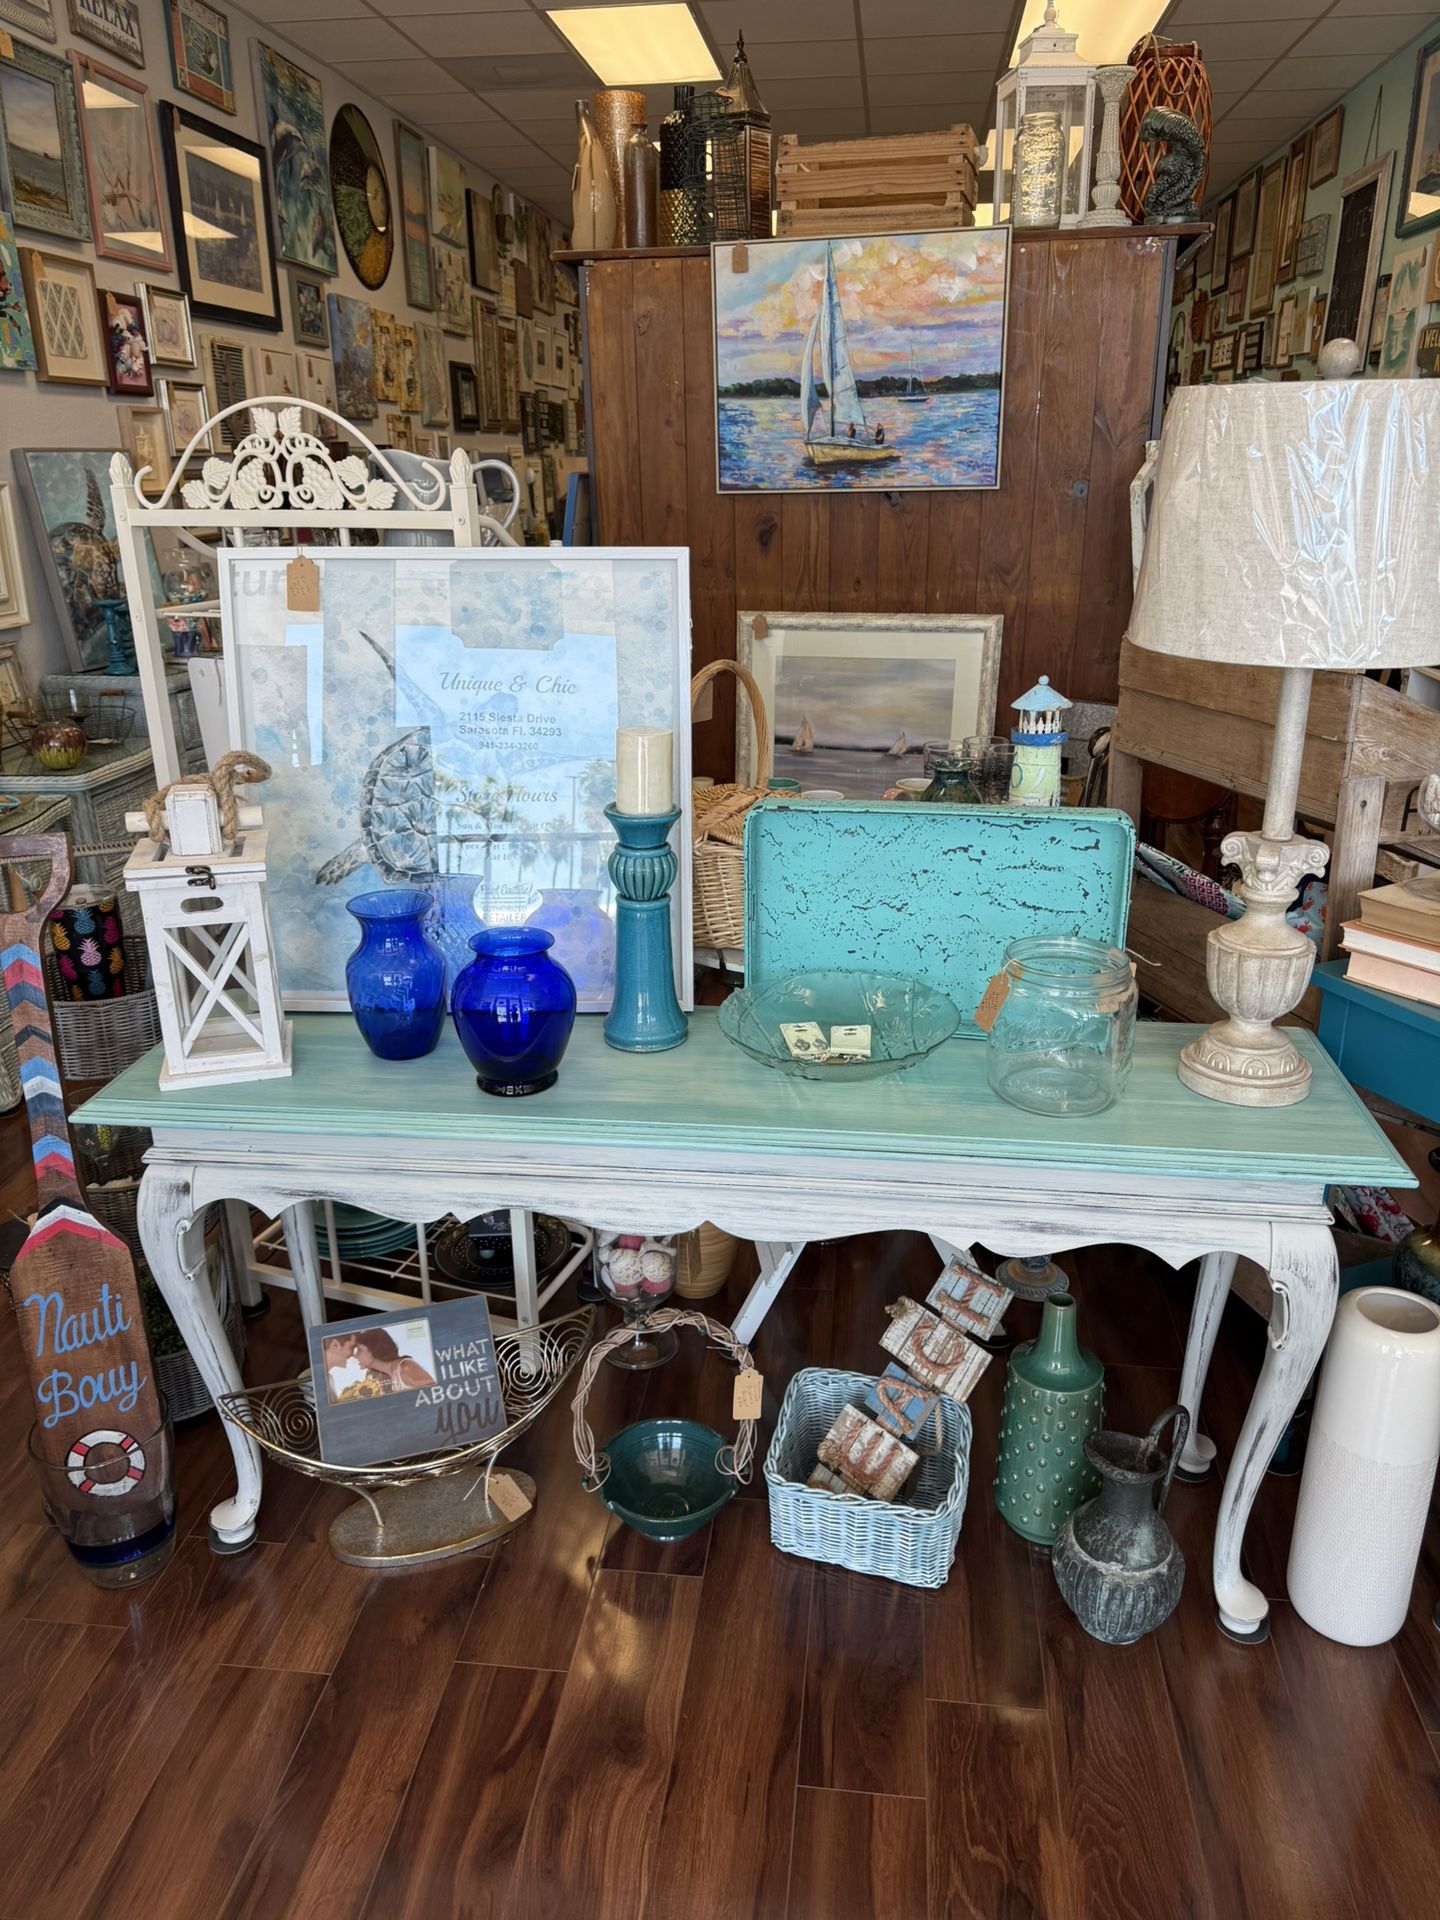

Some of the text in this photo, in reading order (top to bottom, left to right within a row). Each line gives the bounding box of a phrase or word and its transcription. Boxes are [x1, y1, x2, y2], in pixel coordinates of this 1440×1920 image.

[440, 672, 577, 696] Unique & Chic
[459, 711, 556, 724] 2115 Siesta Drive
[459, 725, 509, 736] Sarasota
[529, 727, 562, 737] 34293
[506, 785, 558, 803] Hours
[482, 912, 527, 923] RETAILER
[23, 1283, 132, 1357] Nauti
[435, 1338, 489, 1362] WHAT
[440, 1357, 489, 1380] I LIKE
[37, 1360, 148, 1429] Bouy
[415, 1374, 495, 1408] ABOUT
[434, 1397, 499, 1445] you
